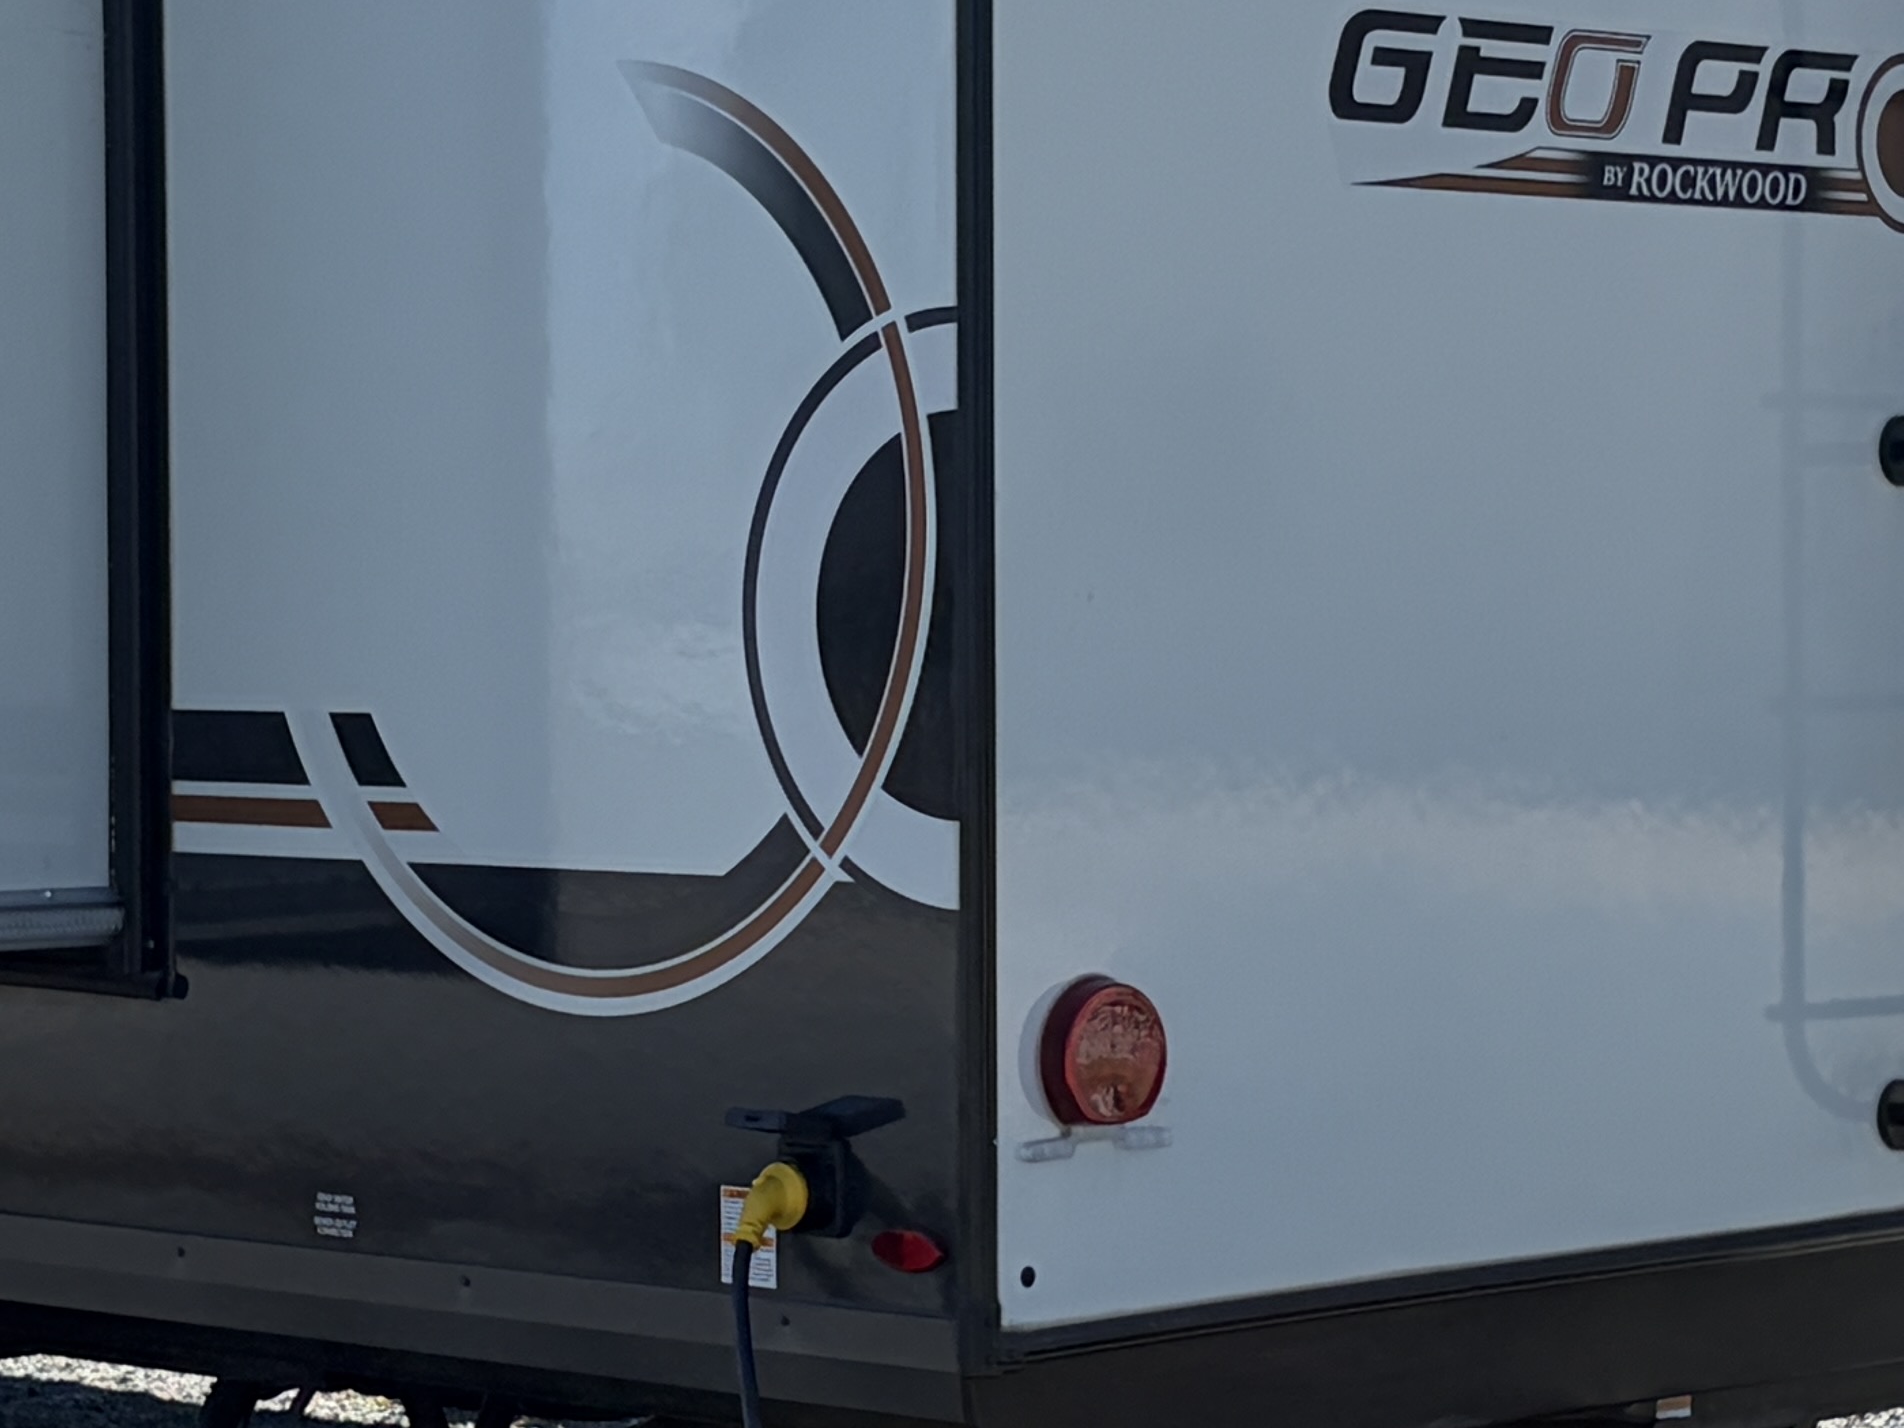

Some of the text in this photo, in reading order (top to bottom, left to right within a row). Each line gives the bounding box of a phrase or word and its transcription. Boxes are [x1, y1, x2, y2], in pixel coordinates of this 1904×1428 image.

[1328, 8, 1652, 140] GEO
[1602, 165, 1808, 207] BY ROCKWOOD
